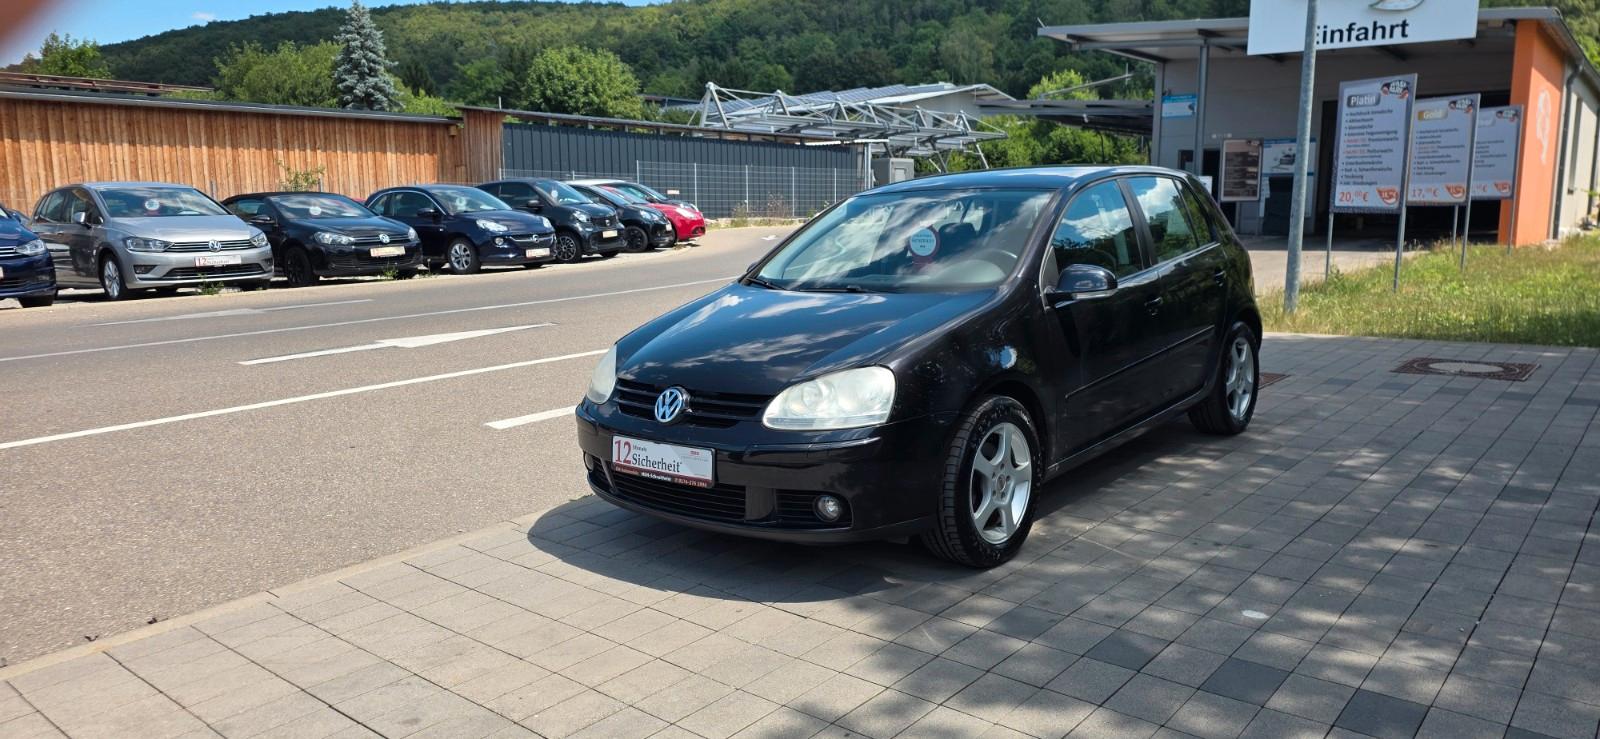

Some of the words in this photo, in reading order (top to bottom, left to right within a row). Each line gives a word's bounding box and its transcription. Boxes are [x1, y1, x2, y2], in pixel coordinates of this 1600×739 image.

[1316, 18, 1409, 45] infahrt
[1350, 94, 1376, 107] Platin
[655, 387, 683, 423] VW
[614, 439, 632, 465] 12
[632, 453, 682, 473] Sicherheit
